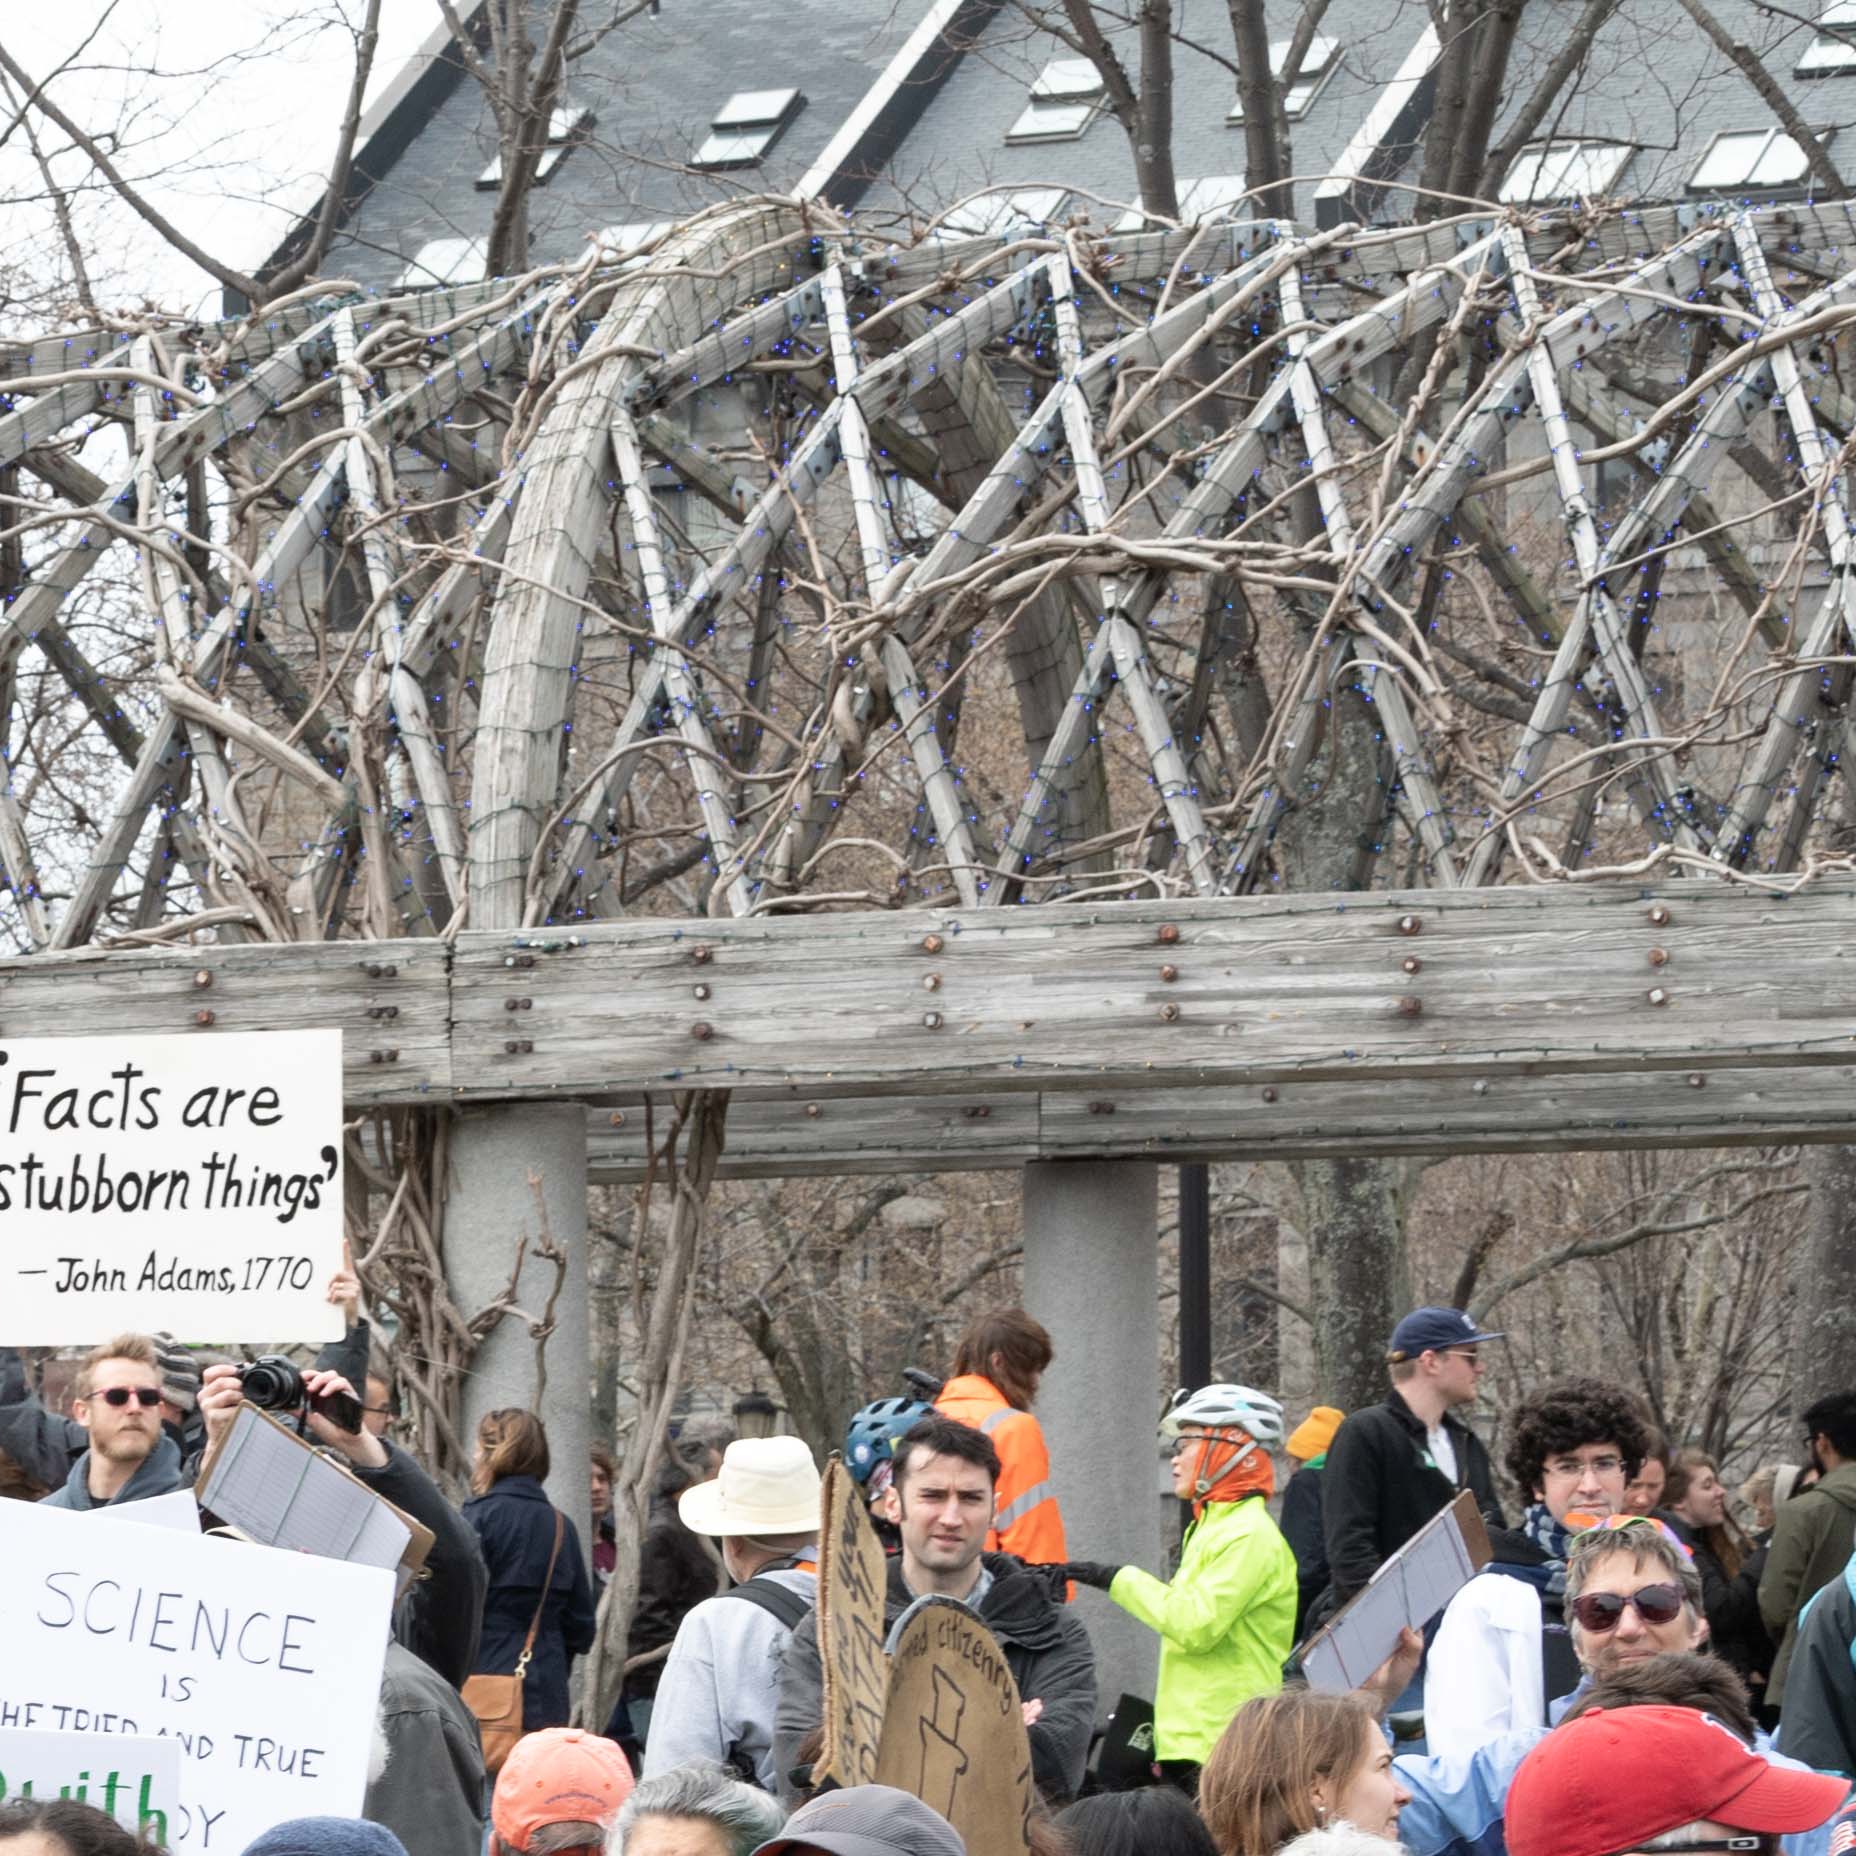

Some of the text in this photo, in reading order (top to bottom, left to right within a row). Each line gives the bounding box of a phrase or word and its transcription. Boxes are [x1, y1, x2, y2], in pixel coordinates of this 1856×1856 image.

[182, 1085, 283, 1128] are
[56, 1257, 127, 1294] John
[240, 1256, 314, 1292] 1770
[36, 1571, 316, 1675] SCIENCE
[938, 1612, 1015, 1716] citizenry
[160, 1672, 199, 1703] IS
[234, 1734, 326, 1778] TRUE
